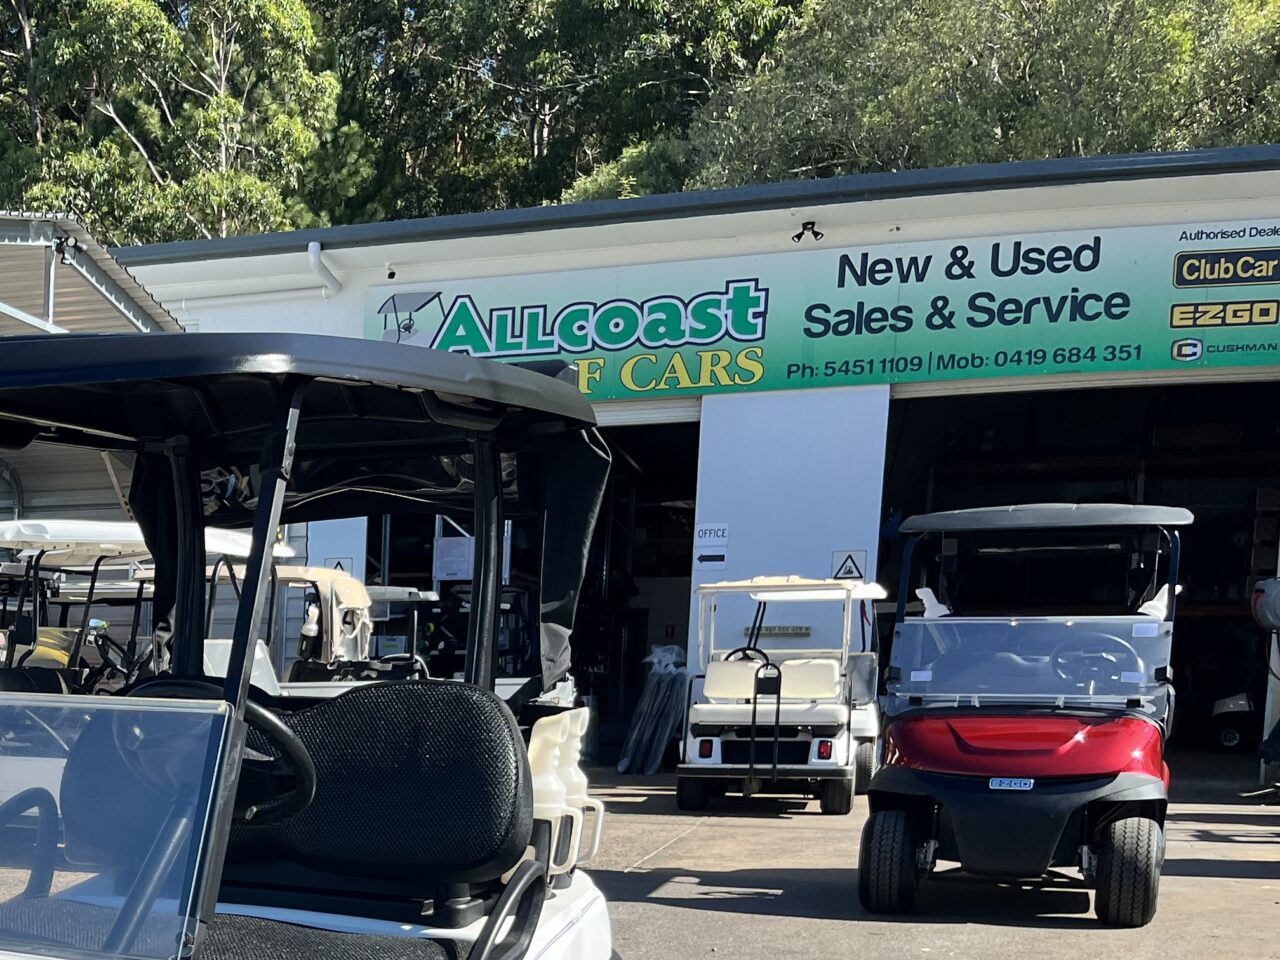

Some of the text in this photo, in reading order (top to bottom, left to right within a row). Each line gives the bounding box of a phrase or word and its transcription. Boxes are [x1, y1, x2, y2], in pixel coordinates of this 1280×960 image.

[1179, 227, 1246, 241] Authorised
[837, 236, 1101, 289] New & Used
[1182, 256, 1279, 281] Club Car
[803, 287, 1131, 339] Sales & Service
[787, 363, 819, 379] Ph:
[823, 359, 874, 377] 5451
[879, 356, 924, 374] 1109
[936, 353, 989, 370] Mob:
[994, 349, 1047, 367] 0419
[1052, 346, 1097, 364] 684
[1103, 344, 1142, 362] 351
[1206, 342, 1278, 354] CUSHMAN
[619, 346, 765, 392] CARS
[698, 528, 727, 539] OFFICE
